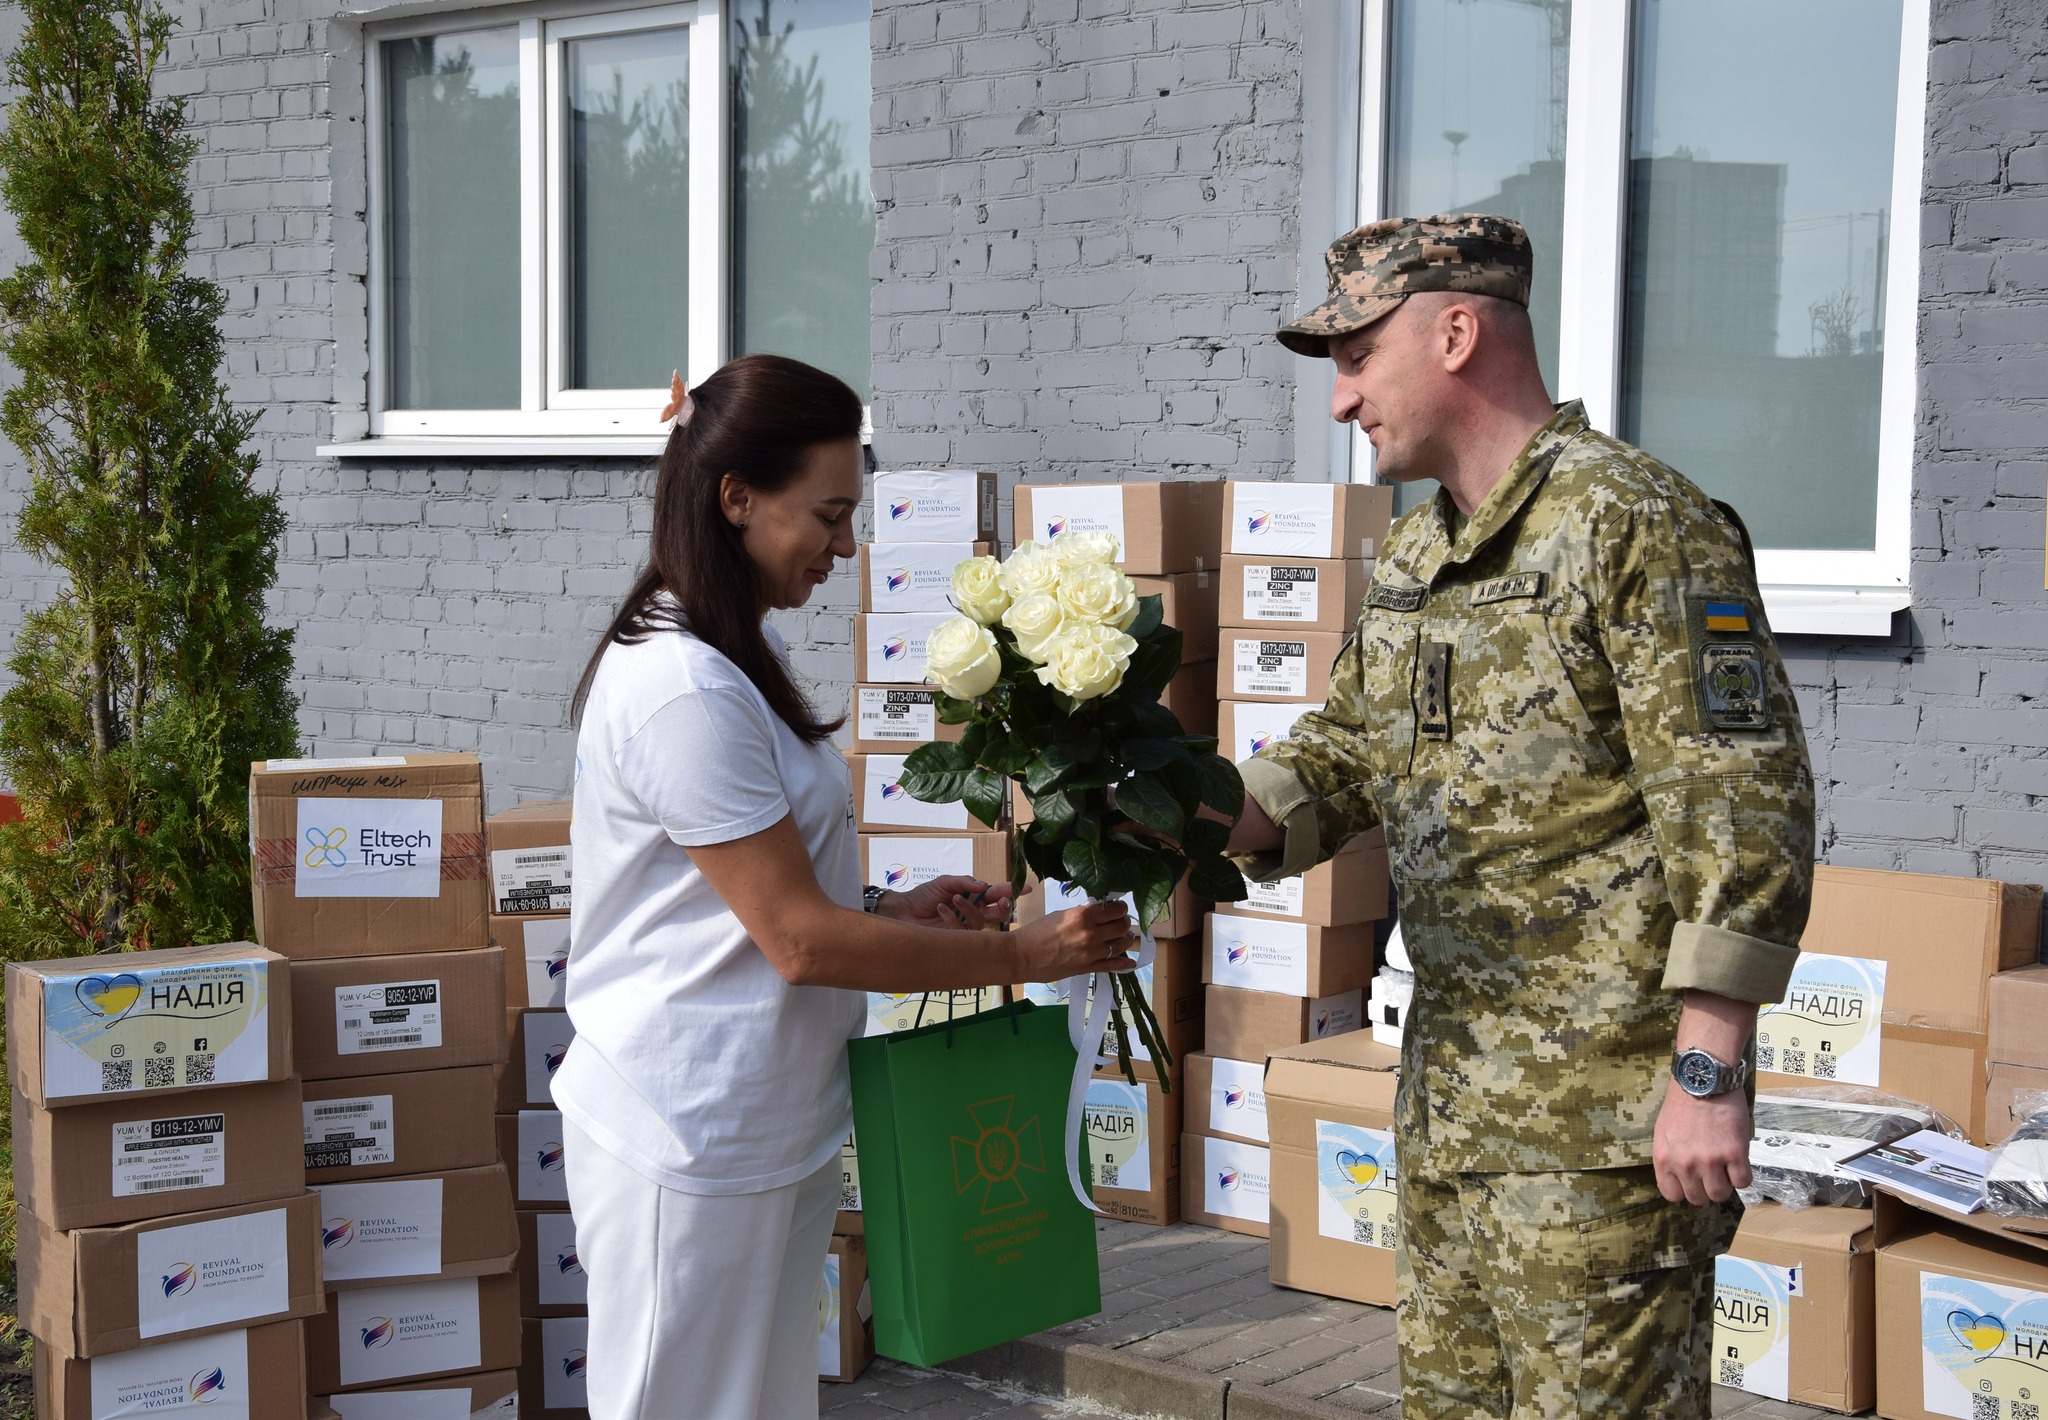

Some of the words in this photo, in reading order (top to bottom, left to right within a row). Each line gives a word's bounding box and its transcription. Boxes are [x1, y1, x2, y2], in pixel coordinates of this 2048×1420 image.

[1272, 568, 1314, 580] 9173-07-YMV
[1479, 586, 1484, 597] A
[1378, 595, 1406, 608] BORDER
[1262, 643, 1303, 655] 9173-07-YMV
[1710, 649, 1752, 657] ДЕРЖАВНА
[888, 692, 931, 702] 9173-07-YMV
[360, 828, 431, 848] Eltech
[360, 849, 416, 866] Trust
[502, 898, 548, 912] 9018-09-YMV
[1252, 952, 1292, 961] FOUNDATION
[161, 968, 211, 976] Благодійний
[1793, 985, 1829, 993] молодіжної
[1800, 978, 1838, 988] Благодійний
[151, 981, 243, 1010] НАДІЯ
[387, 987, 434, 1003] 9052-12-YVP
[1790, 991, 1863, 1019] НАДІЯ
[116, 1127, 135, 1135] YUM
[137, 1125, 150, 1133] V's
[154, 1118, 221, 1136] 9119-12-YMV
[154, 1140, 173, 1148] VINEGAR
[306, 1142, 344, 1151] MAGNESIUM
[1243, 1172, 1267, 1182] REVIVAL
[1122, 1205, 1138, 1217] 810
[360, 1218, 397, 1227] REVIVAL
[970, 1207, 1049, 1240] ПРИКОРДОННИЙ
[360, 1225, 419, 1236] FOUNDATION
[202, 1257, 241, 1270] REVIVAL
[202, 1263, 264, 1280] FOUNDATION
[1744, 1288, 1761, 1296] фонд
[1734, 1293, 1768, 1304] ініціативи
[399, 1314, 436, 1325] REVIVAL
[399, 1320, 457, 1334] FOUNDATION
[145, 1379, 169, 1387] SURVIVAL
[118, 1385, 184, 1404] FOUNDATION
[143, 1395, 184, 1409] REVIVAL
